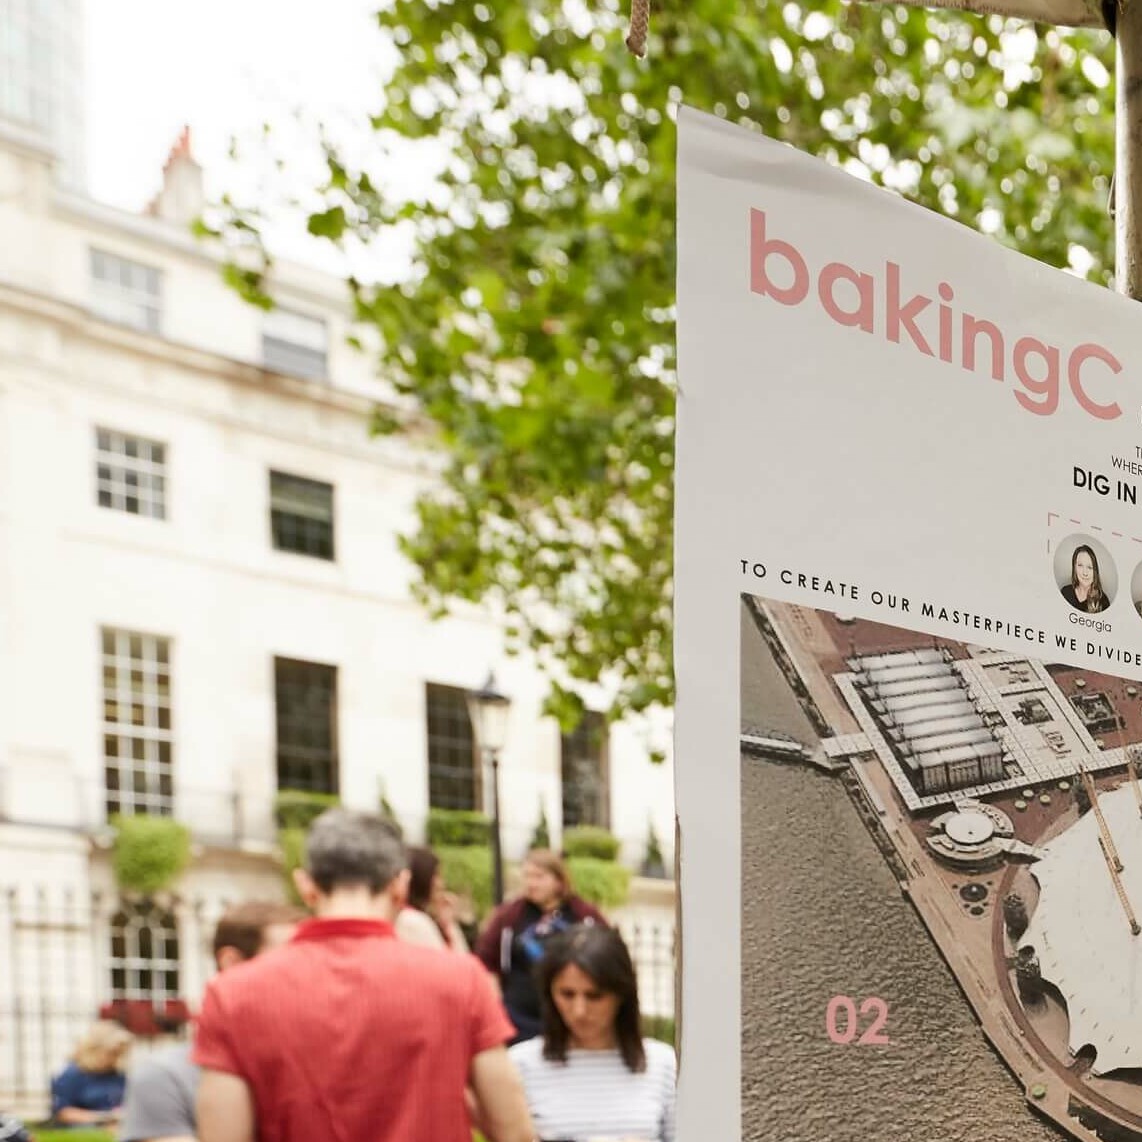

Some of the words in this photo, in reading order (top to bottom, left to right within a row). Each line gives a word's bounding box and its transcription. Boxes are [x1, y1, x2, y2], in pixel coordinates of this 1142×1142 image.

[1074, 466, 1110, 495] DIG
[1118, 480, 1136, 505] IN
[741, 559, 766, 578] TO
[780, 570, 858, 600] CREATE
[871, 591, 909, 612] OUR
[921, 603, 1045, 643] MASTERPIECE
[1055, 634, 1076, 651] WE
[1069, 613, 1112, 632] Georgia
[825, 996, 890, 1044] 02
